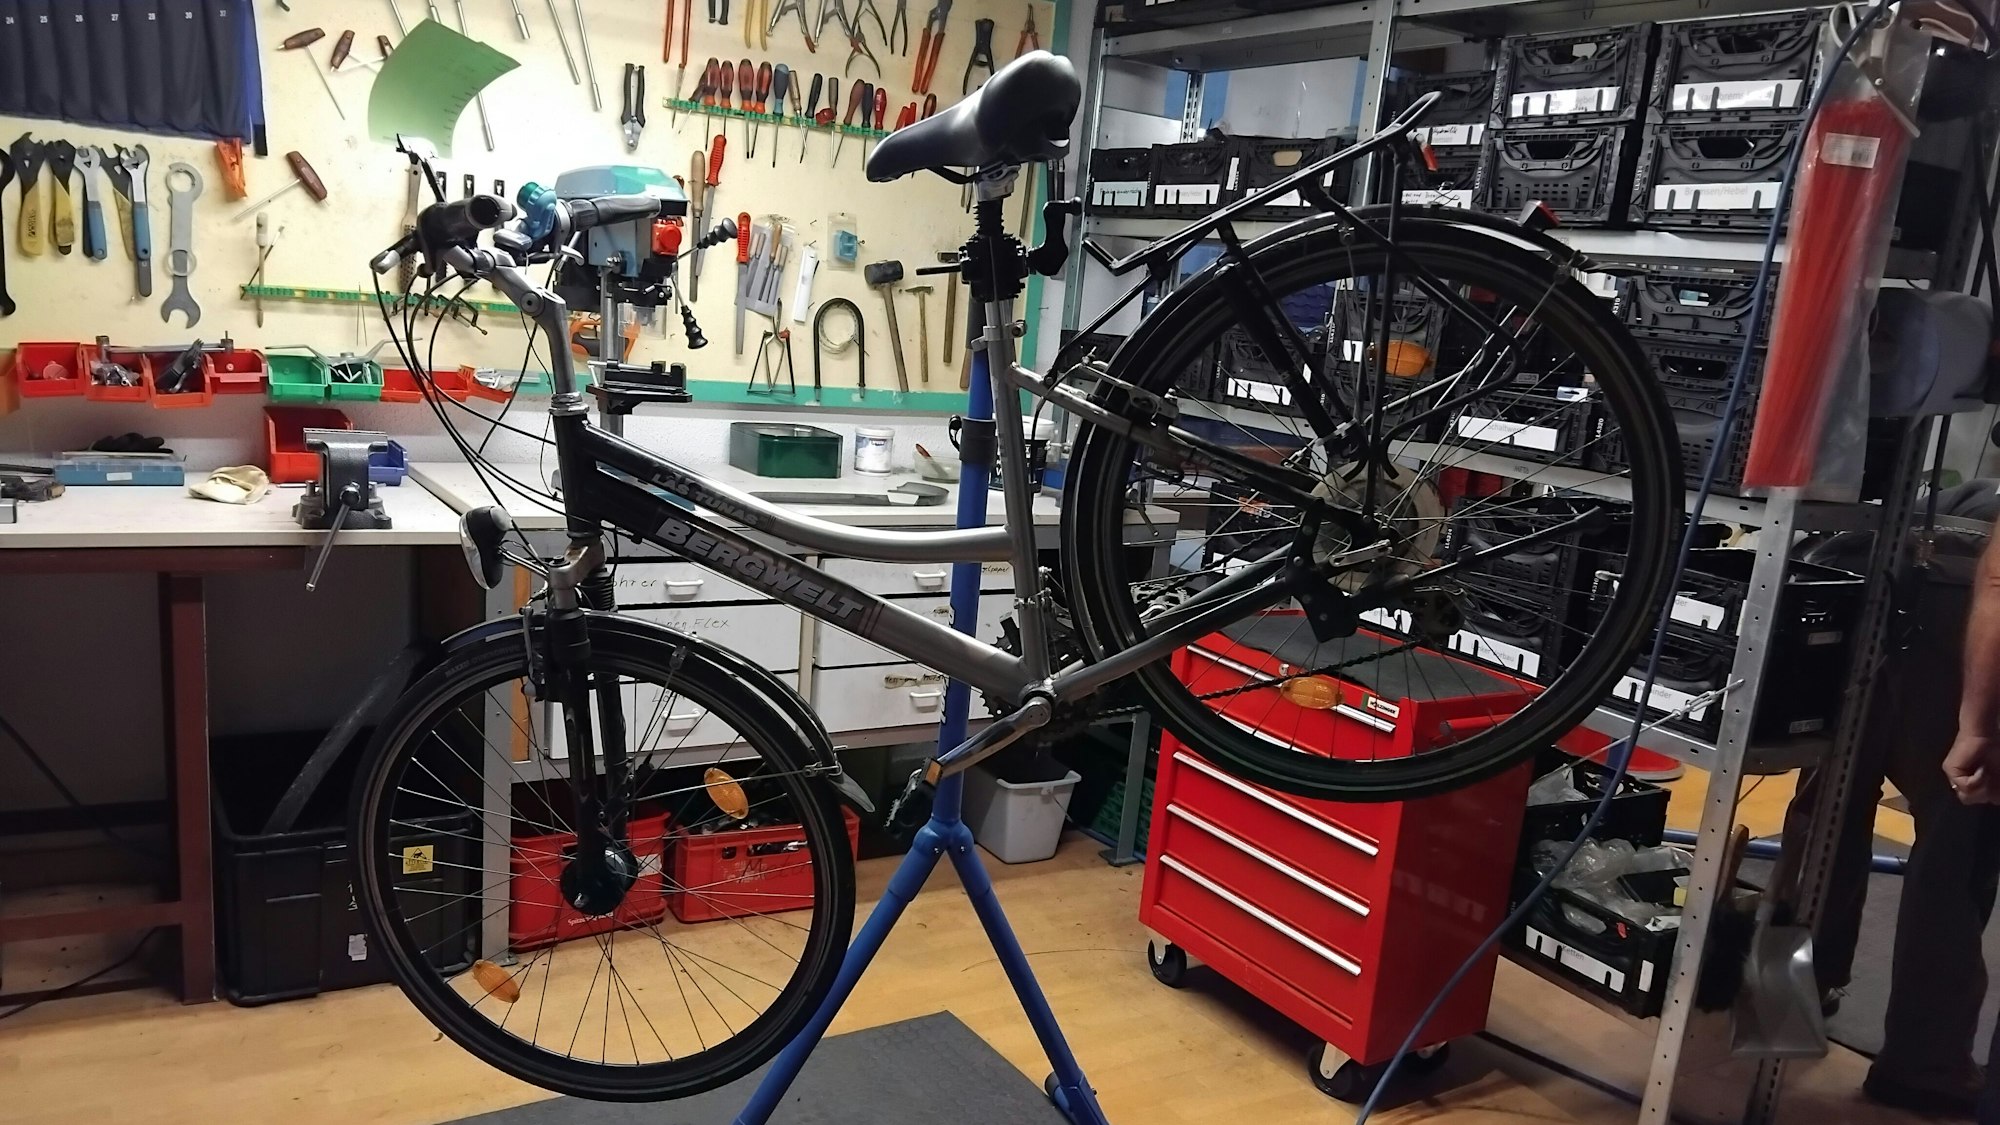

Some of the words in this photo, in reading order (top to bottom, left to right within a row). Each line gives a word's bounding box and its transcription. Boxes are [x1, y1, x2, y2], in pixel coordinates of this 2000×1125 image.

[40, 15, 48, 24] 25
[111, 13, 119, 22] 27
[185, 11, 193, 20] 30
[1684, 185, 1748, 197] Brmsen/Hebel
[652, 473, 689, 497] LAS
[695, 490, 759, 526] TUNAS
[655, 517, 864, 619] BERGWELT
[613, 574, 657, 587] ohrer
[1562, 944, 1585, 960] Ketten
